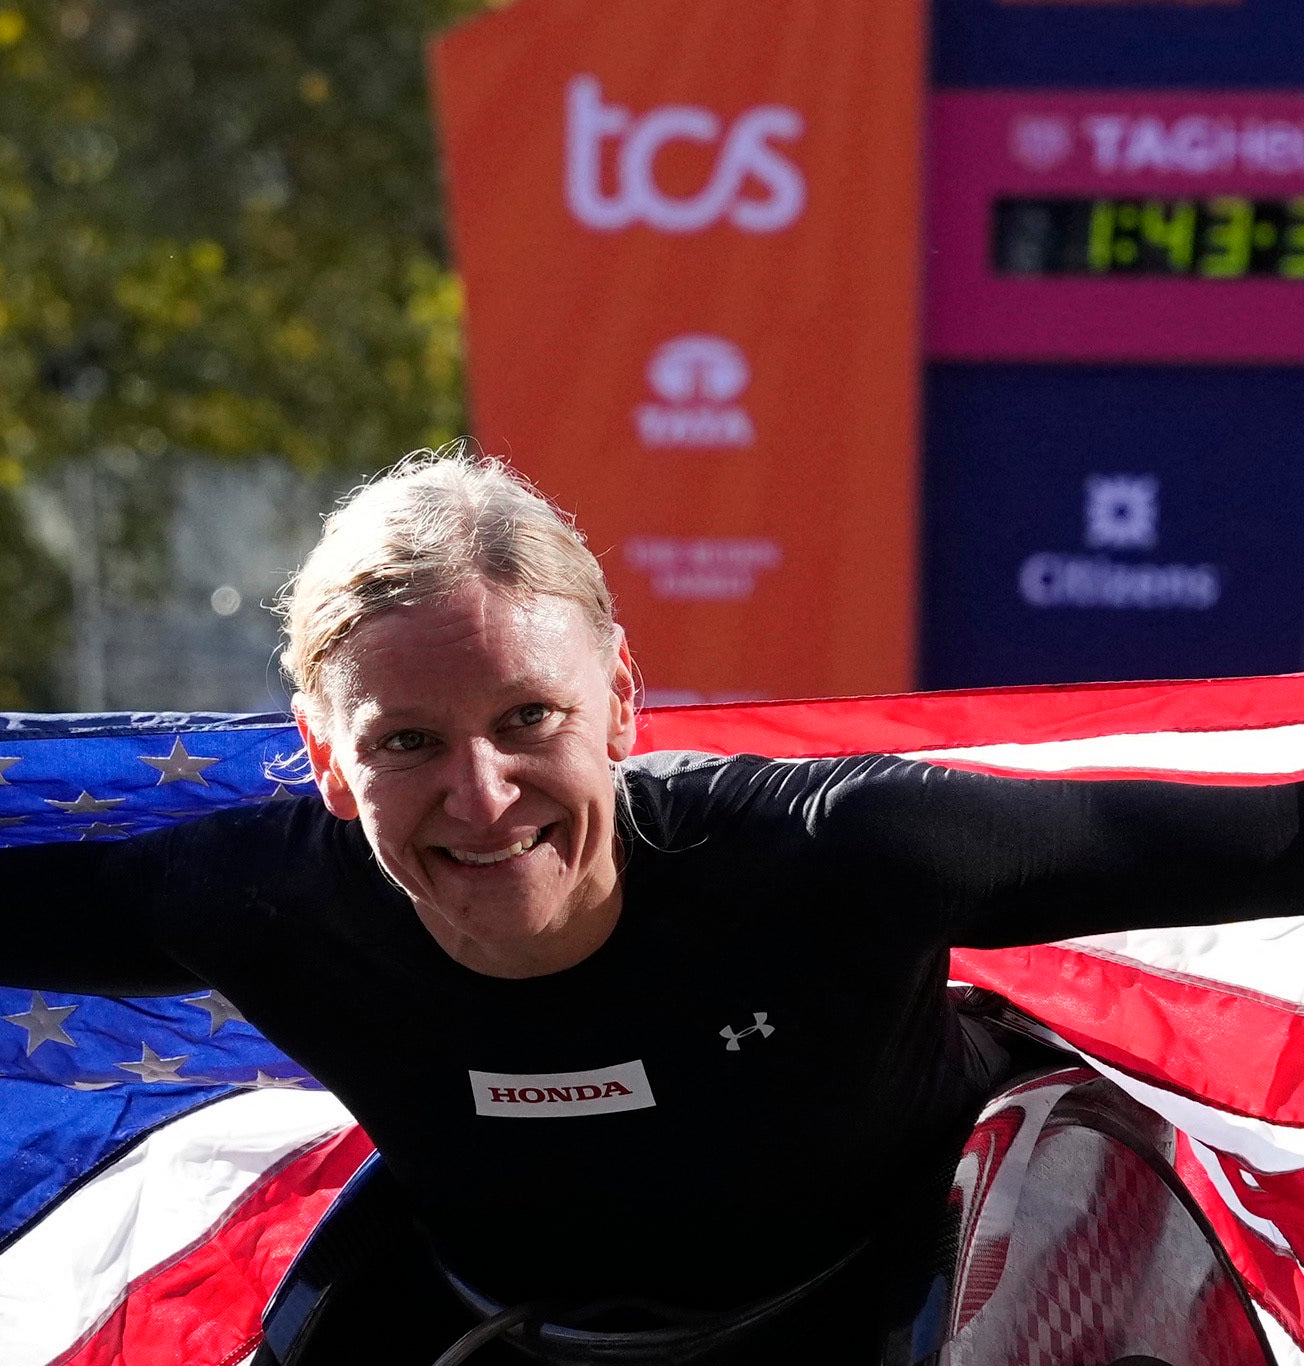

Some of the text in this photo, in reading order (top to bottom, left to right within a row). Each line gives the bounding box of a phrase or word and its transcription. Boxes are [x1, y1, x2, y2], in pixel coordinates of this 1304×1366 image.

[565, 74, 808, 228] tcs
[1020, 553, 1219, 607] Citizens
[487, 1081, 633, 1104] HONDA
